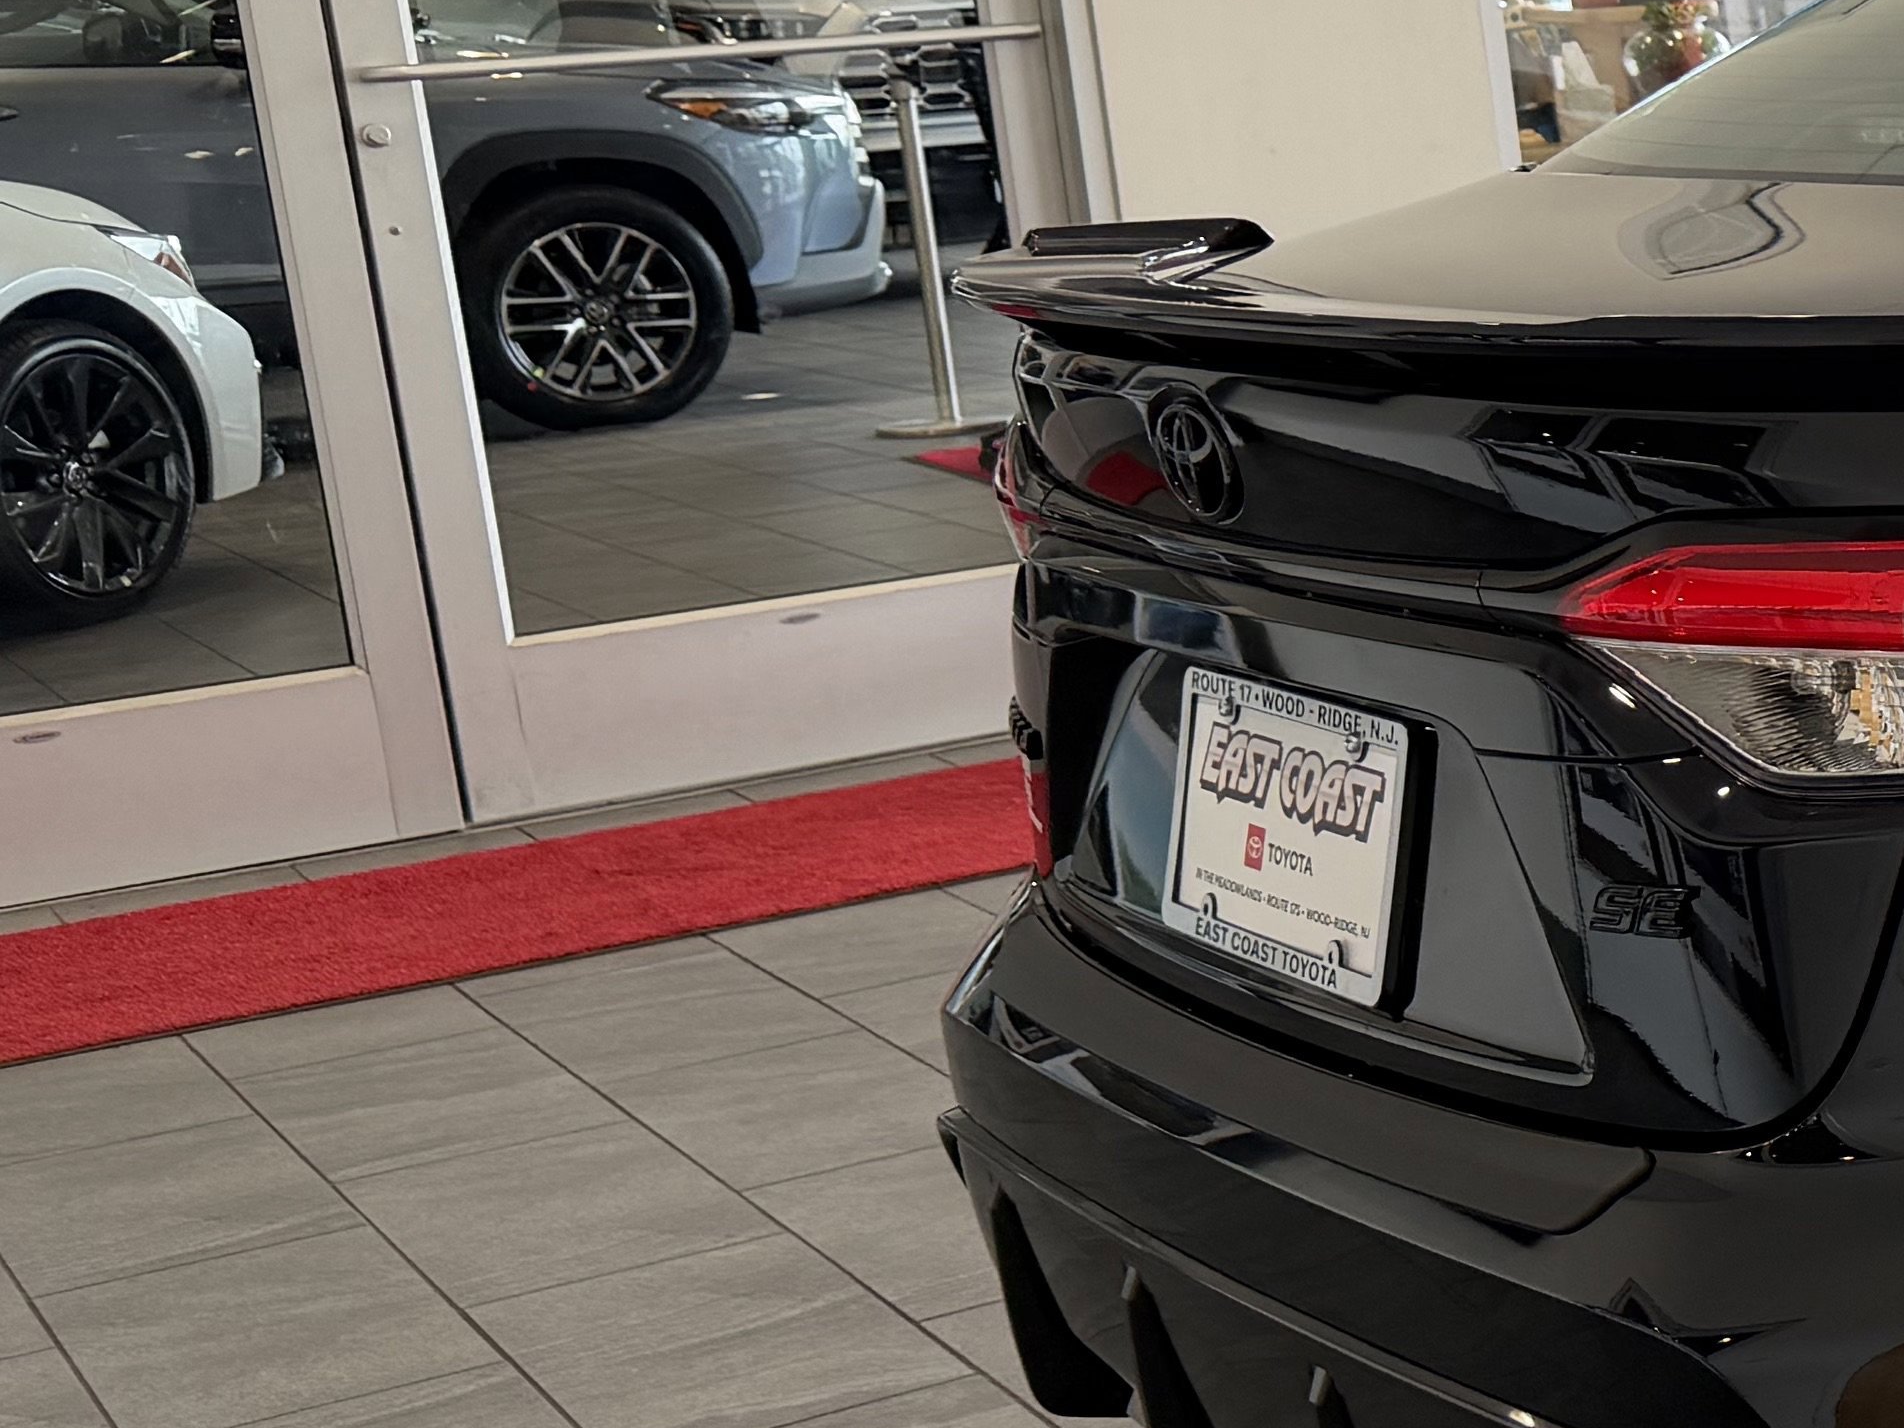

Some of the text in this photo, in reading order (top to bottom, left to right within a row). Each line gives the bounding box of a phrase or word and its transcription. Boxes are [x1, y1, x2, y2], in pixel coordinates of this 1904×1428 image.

[1191, 670, 1235, 699] ROUTE
[1239, 684, 1252, 703] 17
[1262, 690, 1305, 718] WOOD
[1318, 708, 1367, 738] RIDGE,
[1370, 720, 1398, 745] N.J.
[1200, 721, 1386, 843] EAST COAST
[1268, 842, 1313, 876] TOYOTA
[1590, 884, 1692, 939] SE
[1195, 919, 1338, 989] EAST COAST TOYOTA
